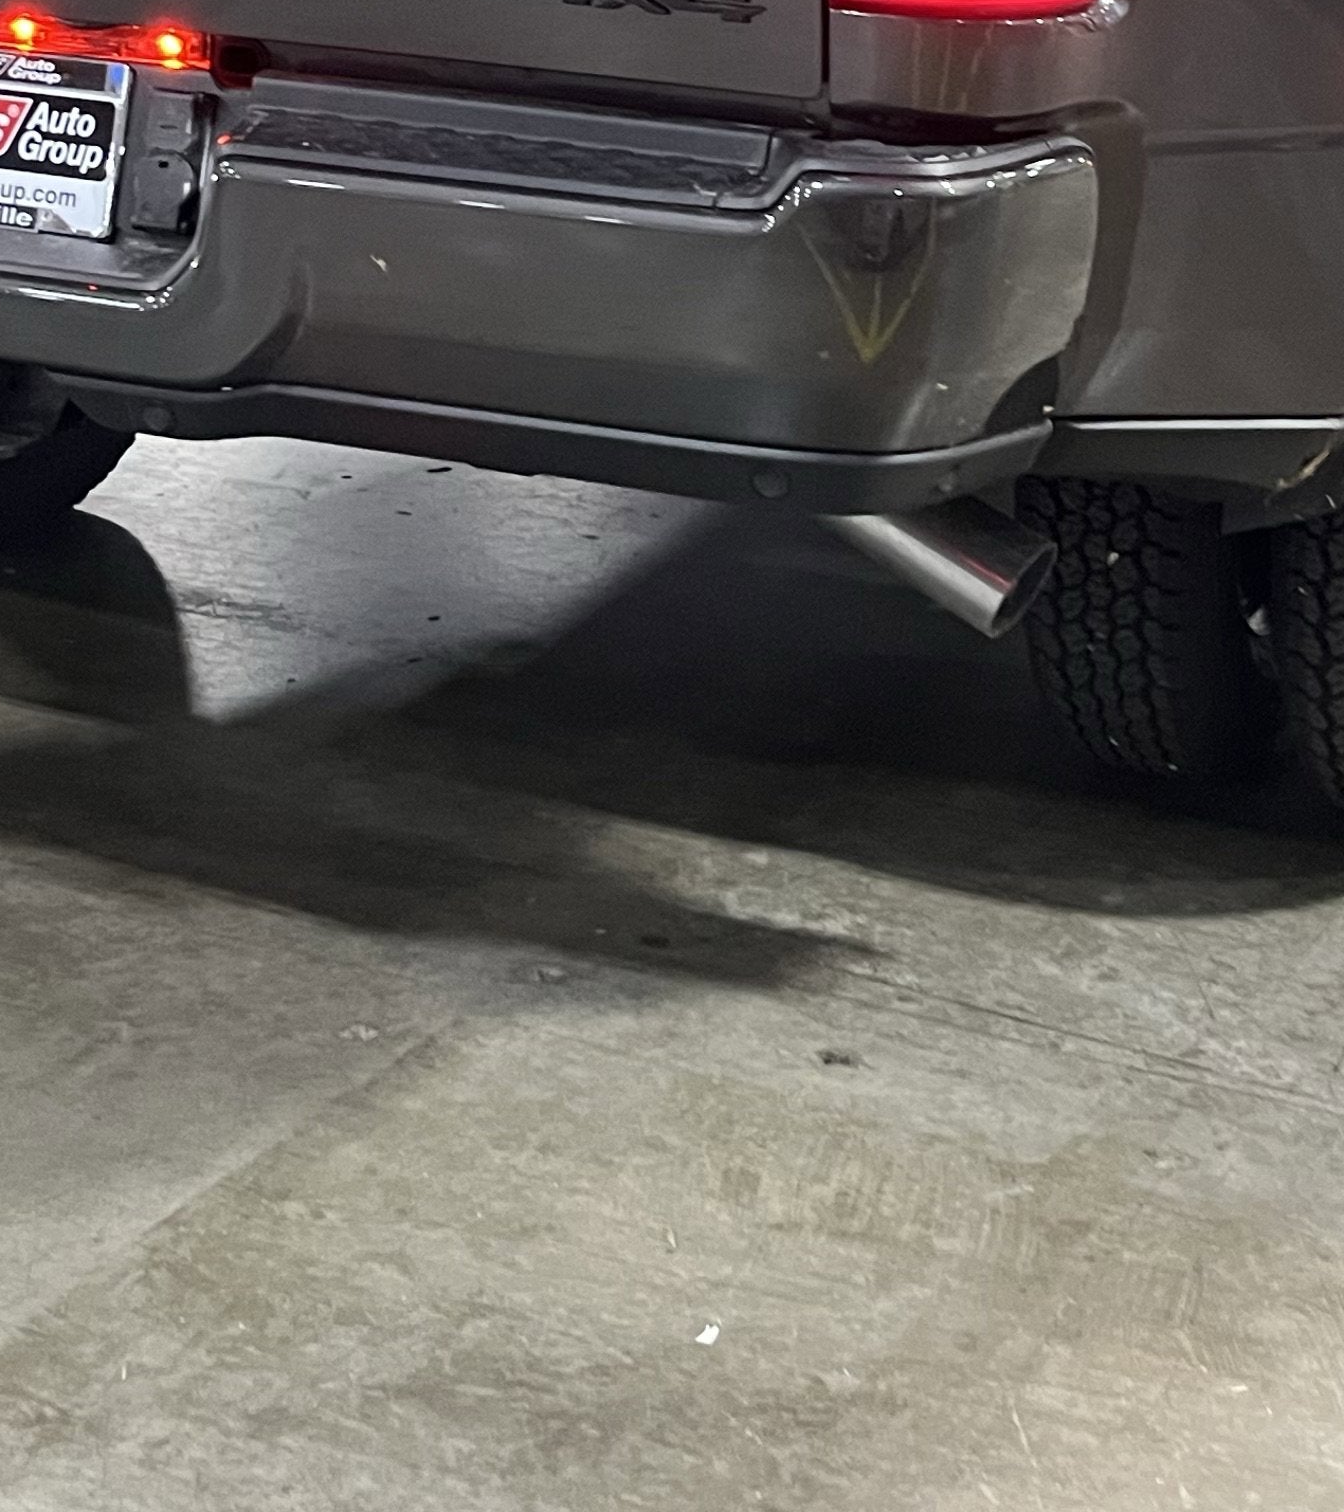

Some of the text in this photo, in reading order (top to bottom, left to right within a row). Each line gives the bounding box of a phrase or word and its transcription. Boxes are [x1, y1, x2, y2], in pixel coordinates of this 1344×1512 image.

[8, 68, 62, 85] Group
[14, 56, 56, 72] Auto
[25, 101, 96, 138] Auto
[17, 130, 103, 174] Group
